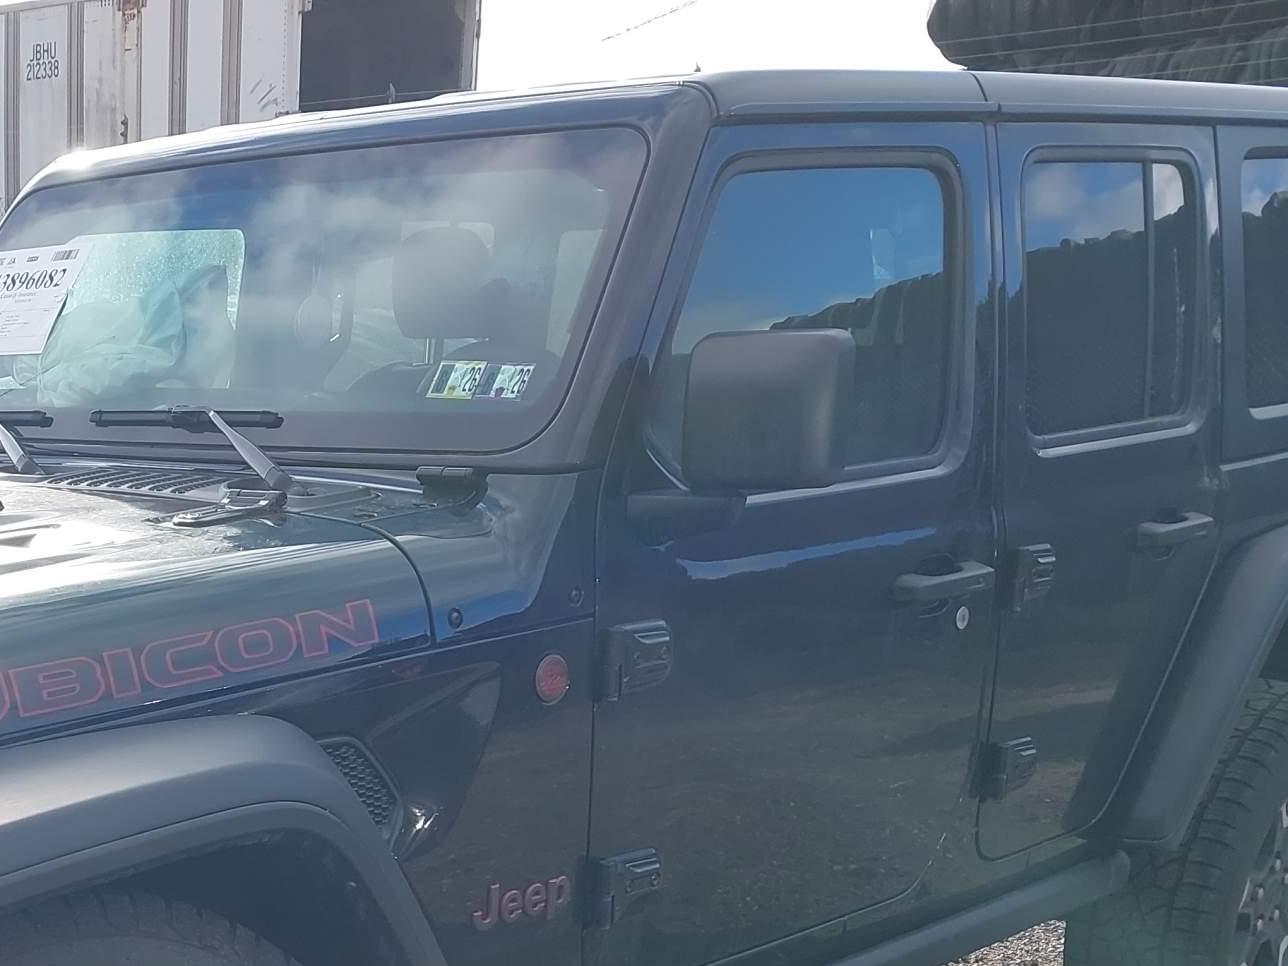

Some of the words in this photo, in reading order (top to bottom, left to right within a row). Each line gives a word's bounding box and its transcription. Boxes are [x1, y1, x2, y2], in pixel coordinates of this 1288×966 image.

[29, 41, 57, 62] JBHU
[25, 59, 60, 81] 212338
[471, 875, 570, 932] Jeep
